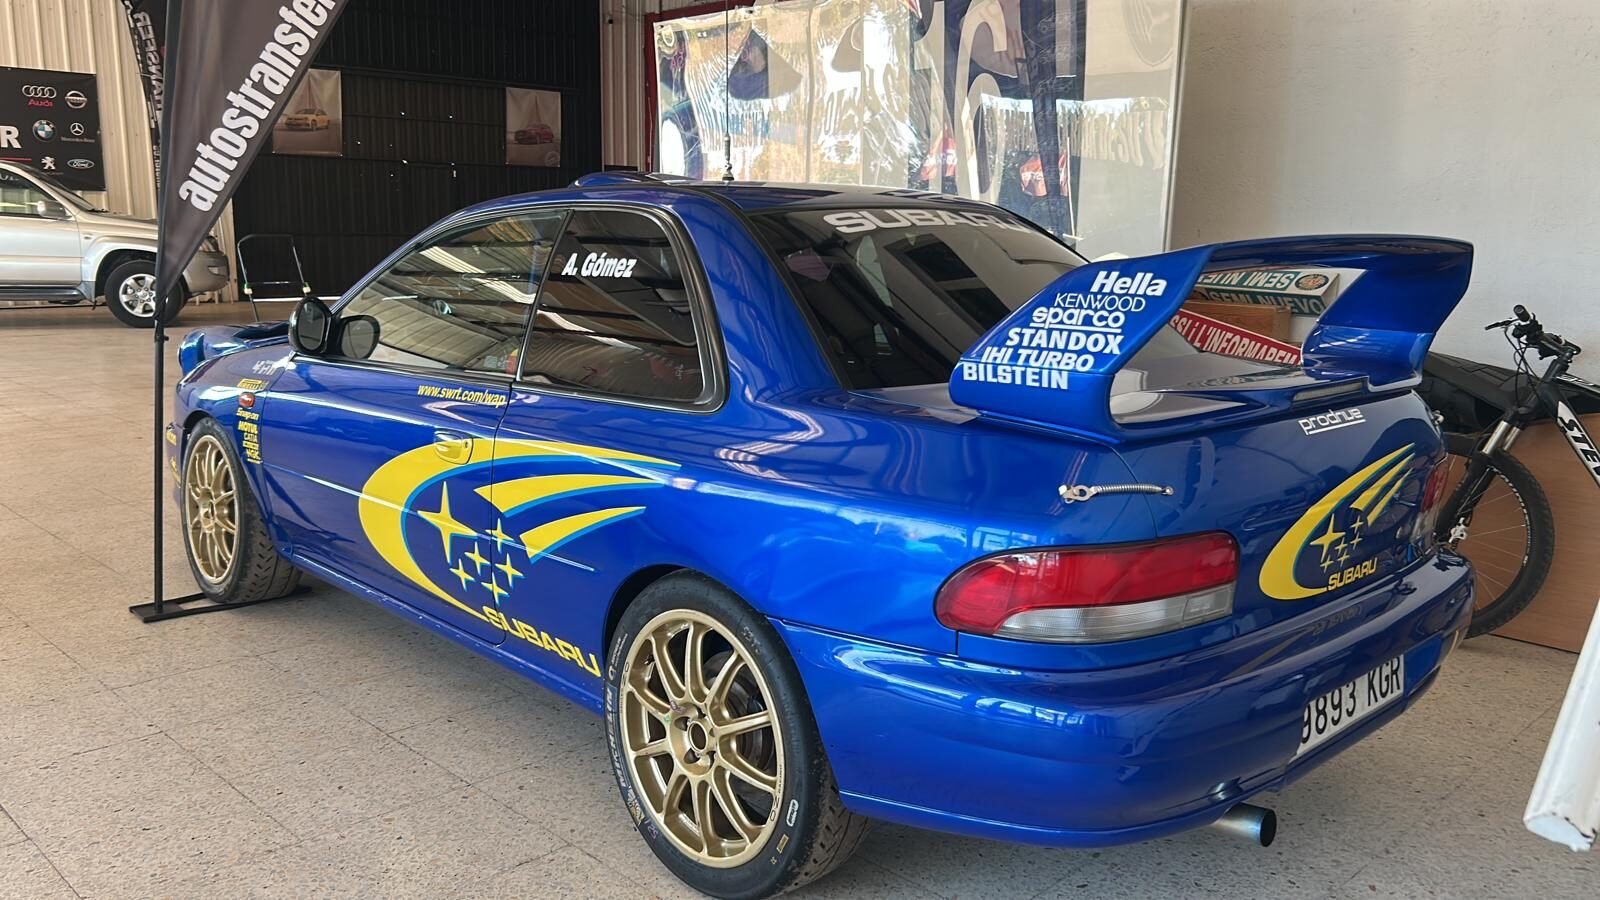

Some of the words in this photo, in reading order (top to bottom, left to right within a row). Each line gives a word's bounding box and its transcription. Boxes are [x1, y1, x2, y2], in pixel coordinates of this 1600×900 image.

[178, 0, 337, 212] autostransfe
[823, 209, 1032, 233] SUBARU
[561, 253, 578, 277] A.
[581, 251, 638, 278] Gómez
[1090, 271, 1168, 296] Hella
[1053, 293, 1146, 312] KENWOOD
[1032, 306, 1125, 329] sparco
[1006, 327, 1124, 355] STANDOX
[981, 346, 1013, 364] IHI
[1016, 349, 1094, 372] TURBO
[962, 362, 1068, 390] BILSTEIN
[417, 383, 507, 407] www.swrt.com/wap
[1328, 558, 1378, 590] SUBARU
[482, 606, 601, 677] SUBARU
[1302, 681, 1356, 744] 9893
[1367, 656, 1401, 706] KGR
